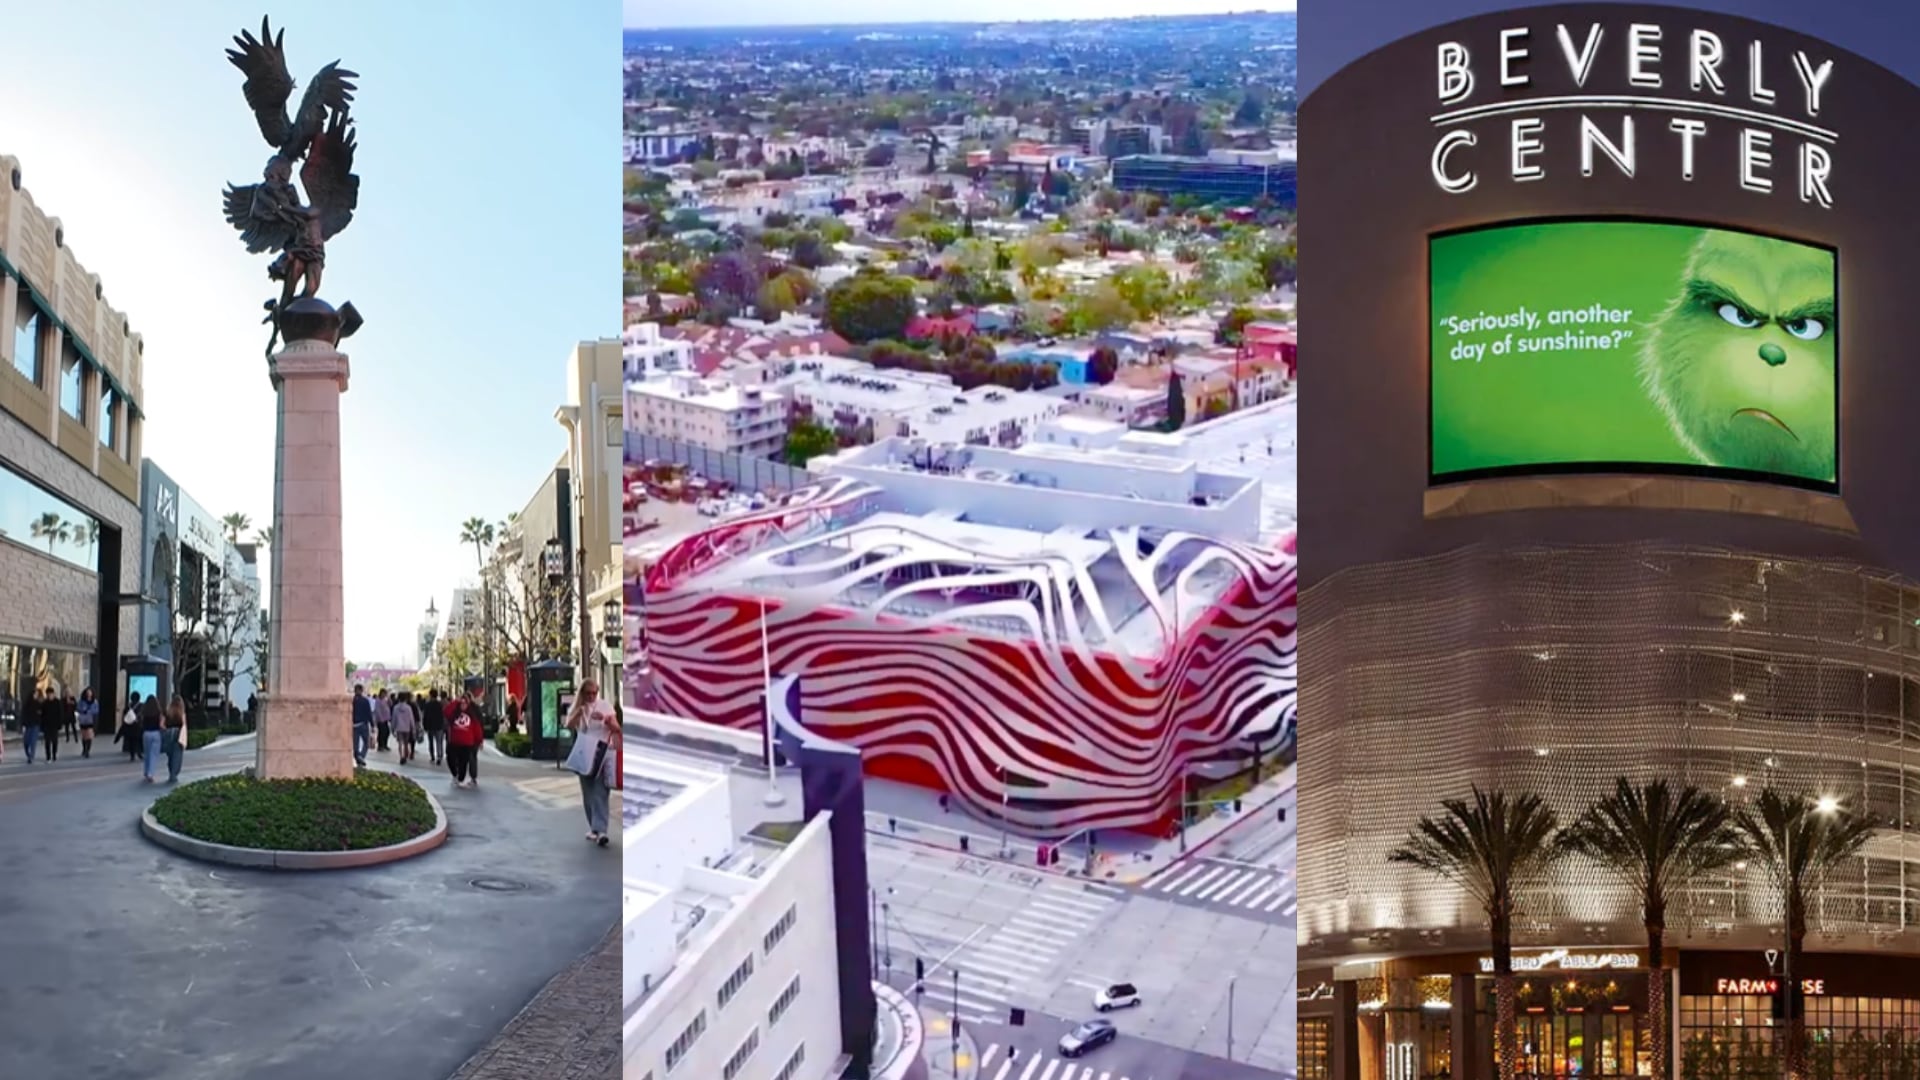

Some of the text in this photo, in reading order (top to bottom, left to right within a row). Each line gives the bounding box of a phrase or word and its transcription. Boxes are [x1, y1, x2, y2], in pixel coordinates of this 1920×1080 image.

[1437, 22, 1834, 116] BEVERLY
[1431, 114, 1834, 208] CENTER
[1547, 303, 1633, 325] another
[1450, 330, 1633, 362] day of sunshine?"
